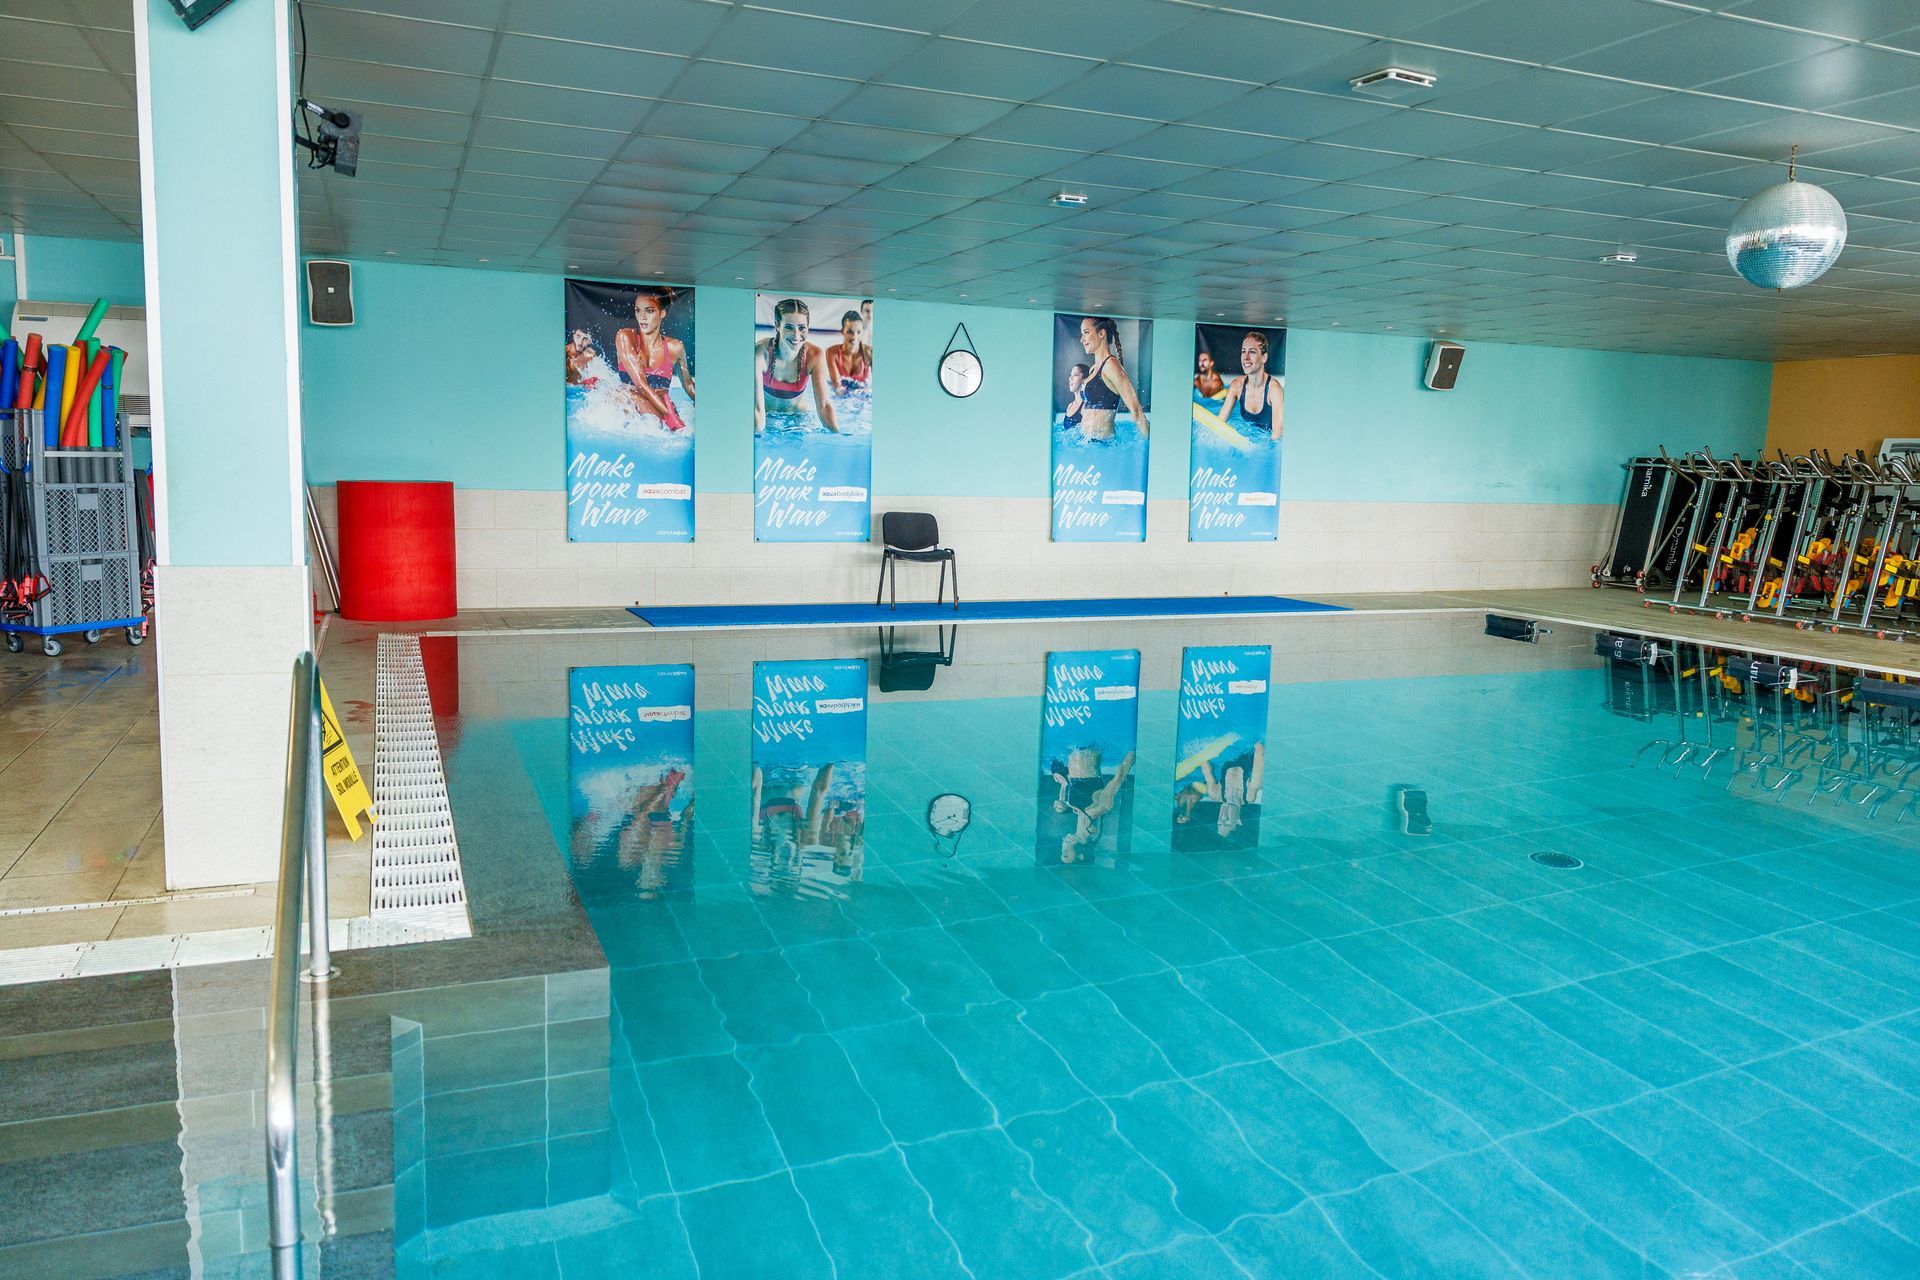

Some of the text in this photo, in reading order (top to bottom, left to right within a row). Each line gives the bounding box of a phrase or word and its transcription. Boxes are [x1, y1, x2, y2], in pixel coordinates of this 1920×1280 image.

[568, 452, 635, 478] Make
[755, 457, 817, 482] Make
[1053, 464, 1102, 487] Make
[1191, 466, 1238, 489] Make
[1641, 458, 1656, 498] ynamika
[642, 487, 687, 496] aquacombat
[821, 490, 865, 499] aquabodybike
[580, 498, 652, 527] Wave
[766, 500, 833, 528] Wave
[1058, 503, 1112, 529] Wave
[1198, 505, 1248, 529] Wave
[1664, 526, 1684, 571] Dynamika
[331, 756, 350, 778] ATTENTION
[336, 782, 346, 796] SOL
